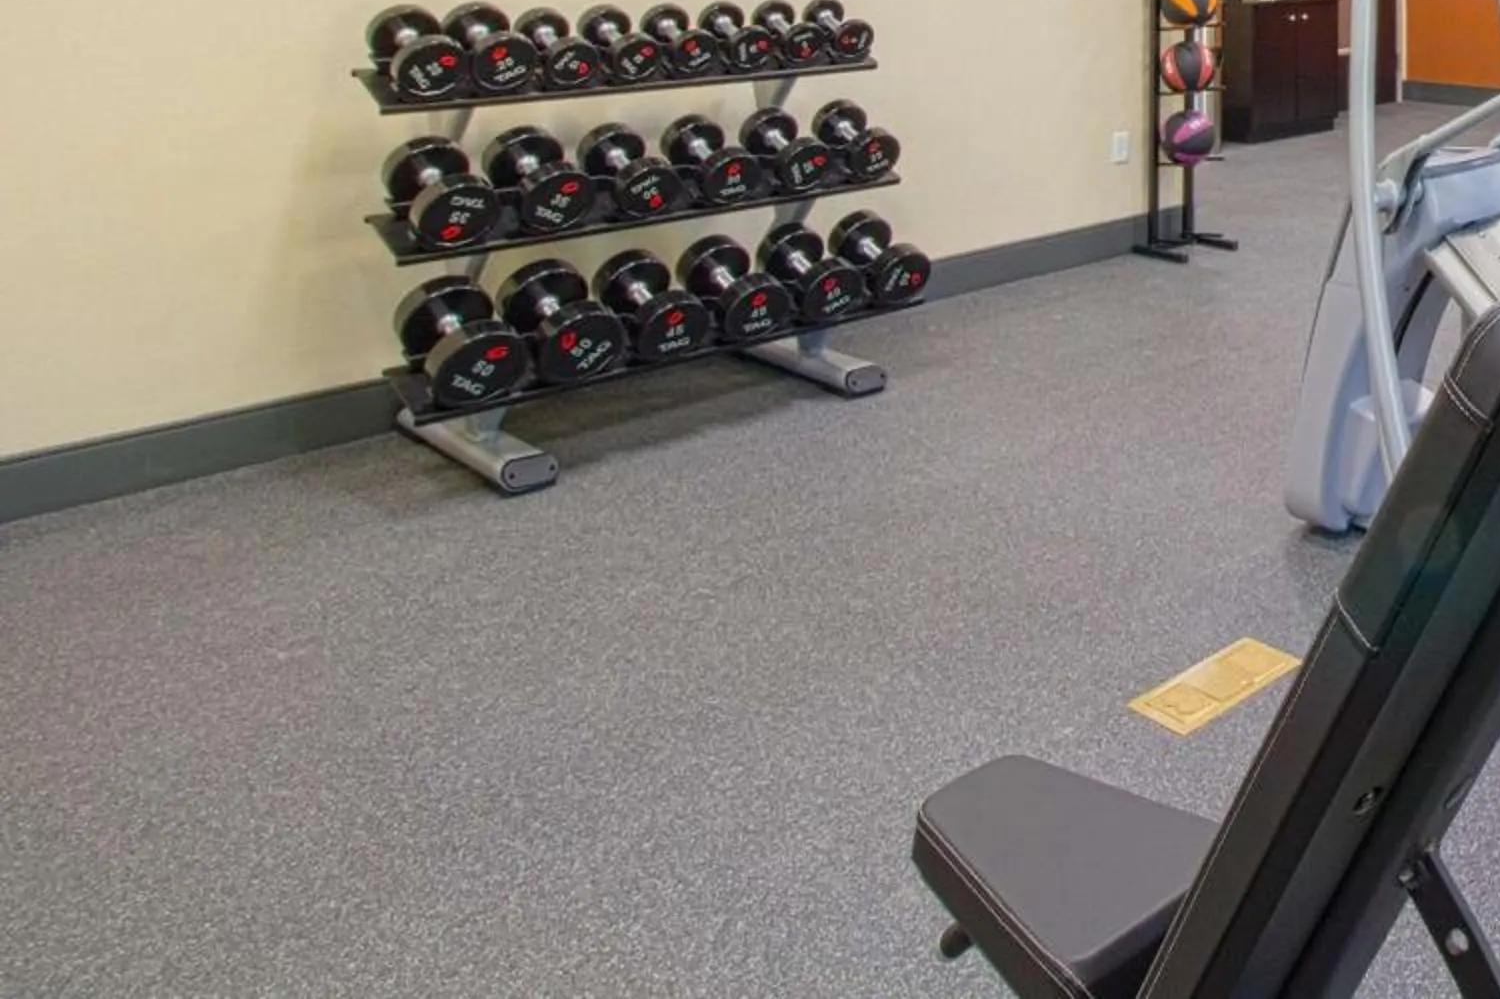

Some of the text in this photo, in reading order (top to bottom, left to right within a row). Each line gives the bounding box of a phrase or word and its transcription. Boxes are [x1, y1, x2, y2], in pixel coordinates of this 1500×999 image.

[720, 184, 746, 196] TAG
[451, 196, 485, 209] TAG
[535, 205, 563, 223] TAG
[658, 336, 692, 352] TAG
[576, 340, 613, 371] TAG
[451, 374, 485, 395] TAG
